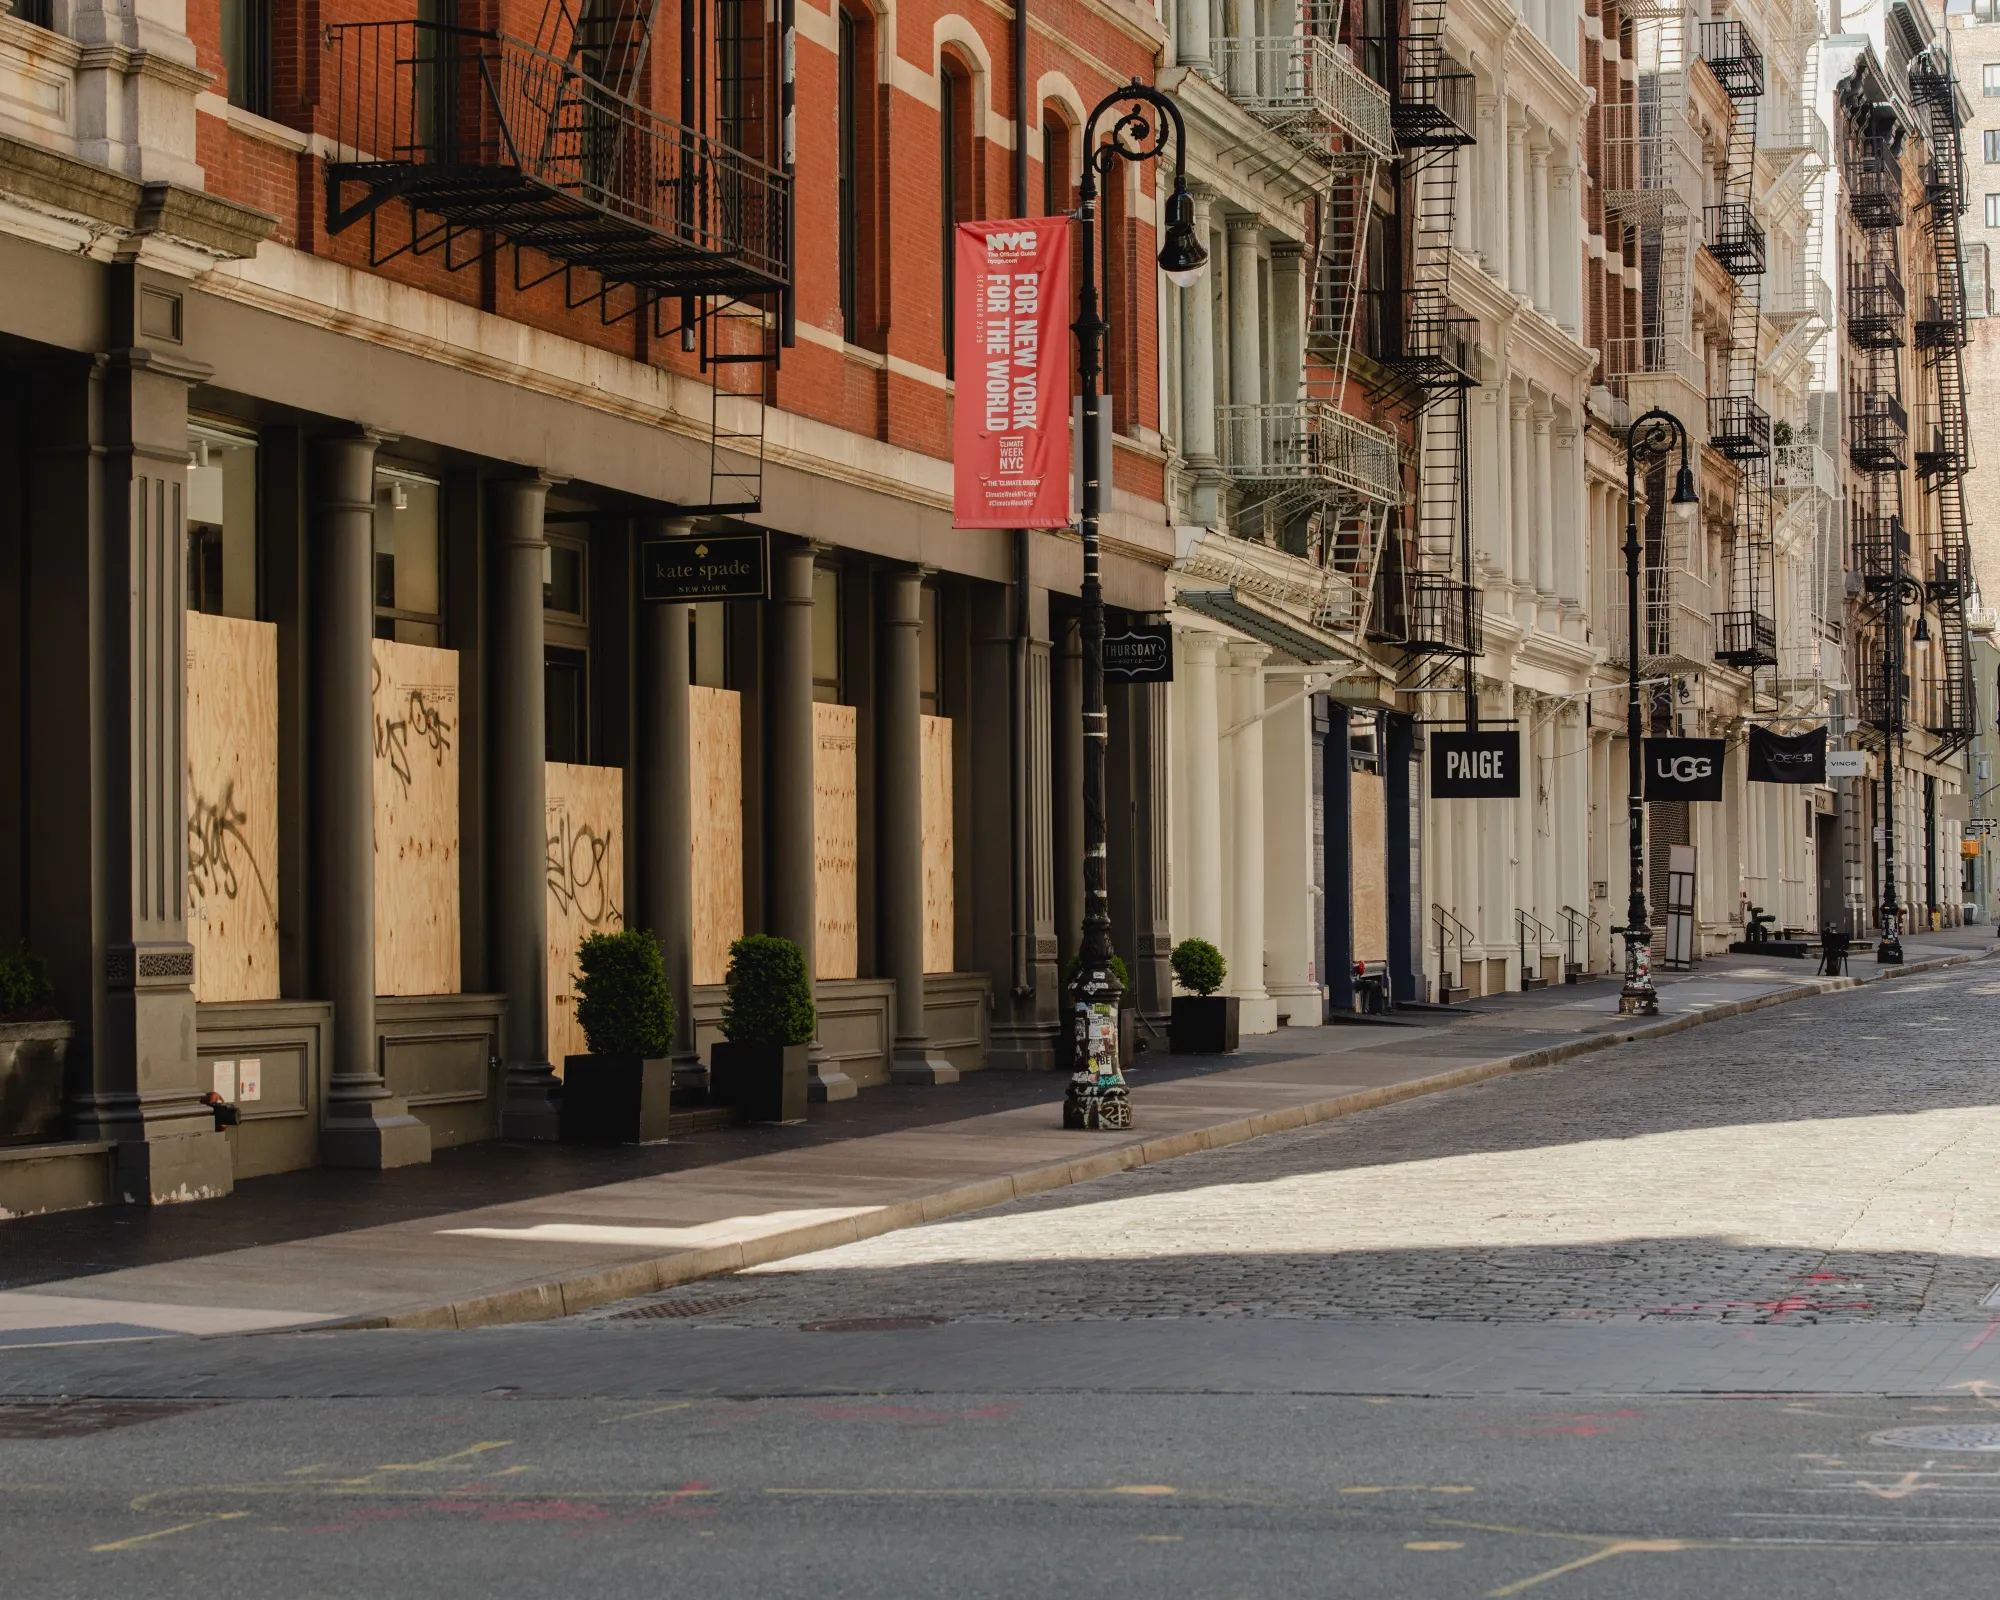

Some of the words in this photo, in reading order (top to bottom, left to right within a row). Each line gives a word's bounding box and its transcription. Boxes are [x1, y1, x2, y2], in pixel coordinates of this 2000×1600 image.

[986, 231, 1037, 251] NYC
[987, 275, 1010, 313] FOR
[1014, 273, 1038, 314] FOR
[987, 317, 1010, 355] THE
[1014, 319, 1038, 367] NEW
[986, 360, 1010, 431] WORLD
[1013, 372, 1037, 430] YORK
[1000, 448, 1024, 457] WEEK
[1000, 457, 1024, 470] NYC
[656, 563, 693, 579] kate
[699, 559, 750, 581] spade
[678, 585, 699, 594] NEW
[702, 584, 728, 592] YORK
[1104, 643, 1157, 657] THURSDAY
[1447, 750, 1504, 779] PAIGE
[1657, 755, 1712, 783] UGG
